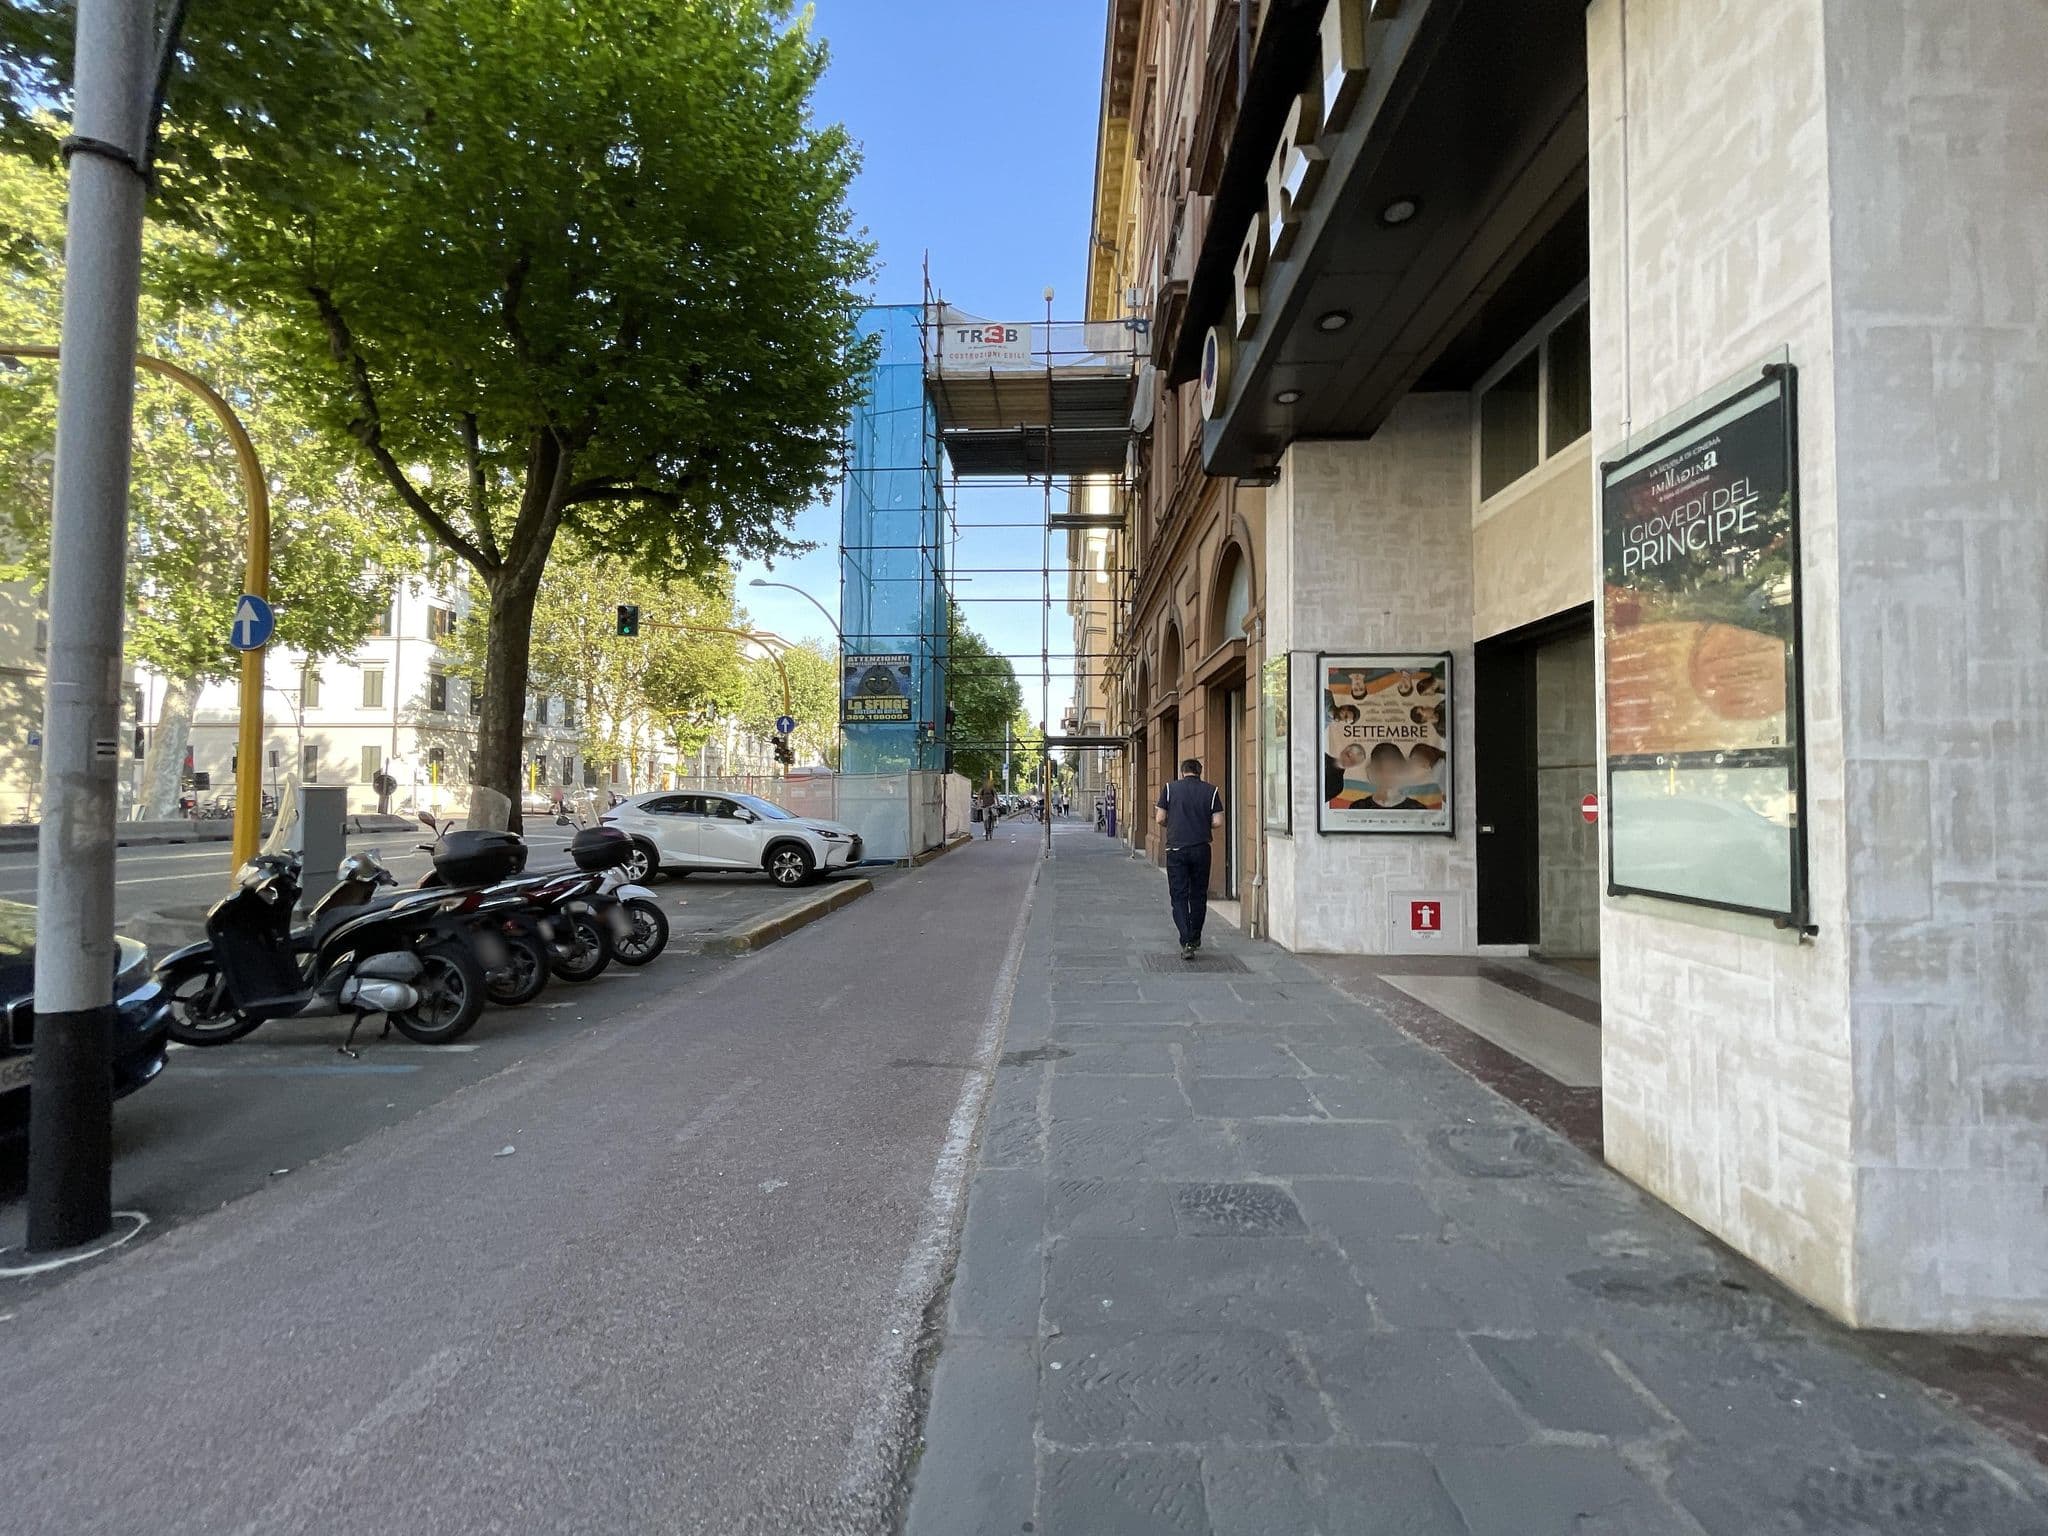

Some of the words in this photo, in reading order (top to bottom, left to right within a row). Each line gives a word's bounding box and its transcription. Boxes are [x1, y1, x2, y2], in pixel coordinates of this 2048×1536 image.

[957, 325, 1018, 343] TR3B
[1622, 527, 1626, 547] I
[1712, 476, 1759, 511] DEL
[1622, 496, 1759, 576] PRINCIPE
[865, 699, 908, 710] SFINGE
[1343, 725, 1428, 738] SETTEMBRE
